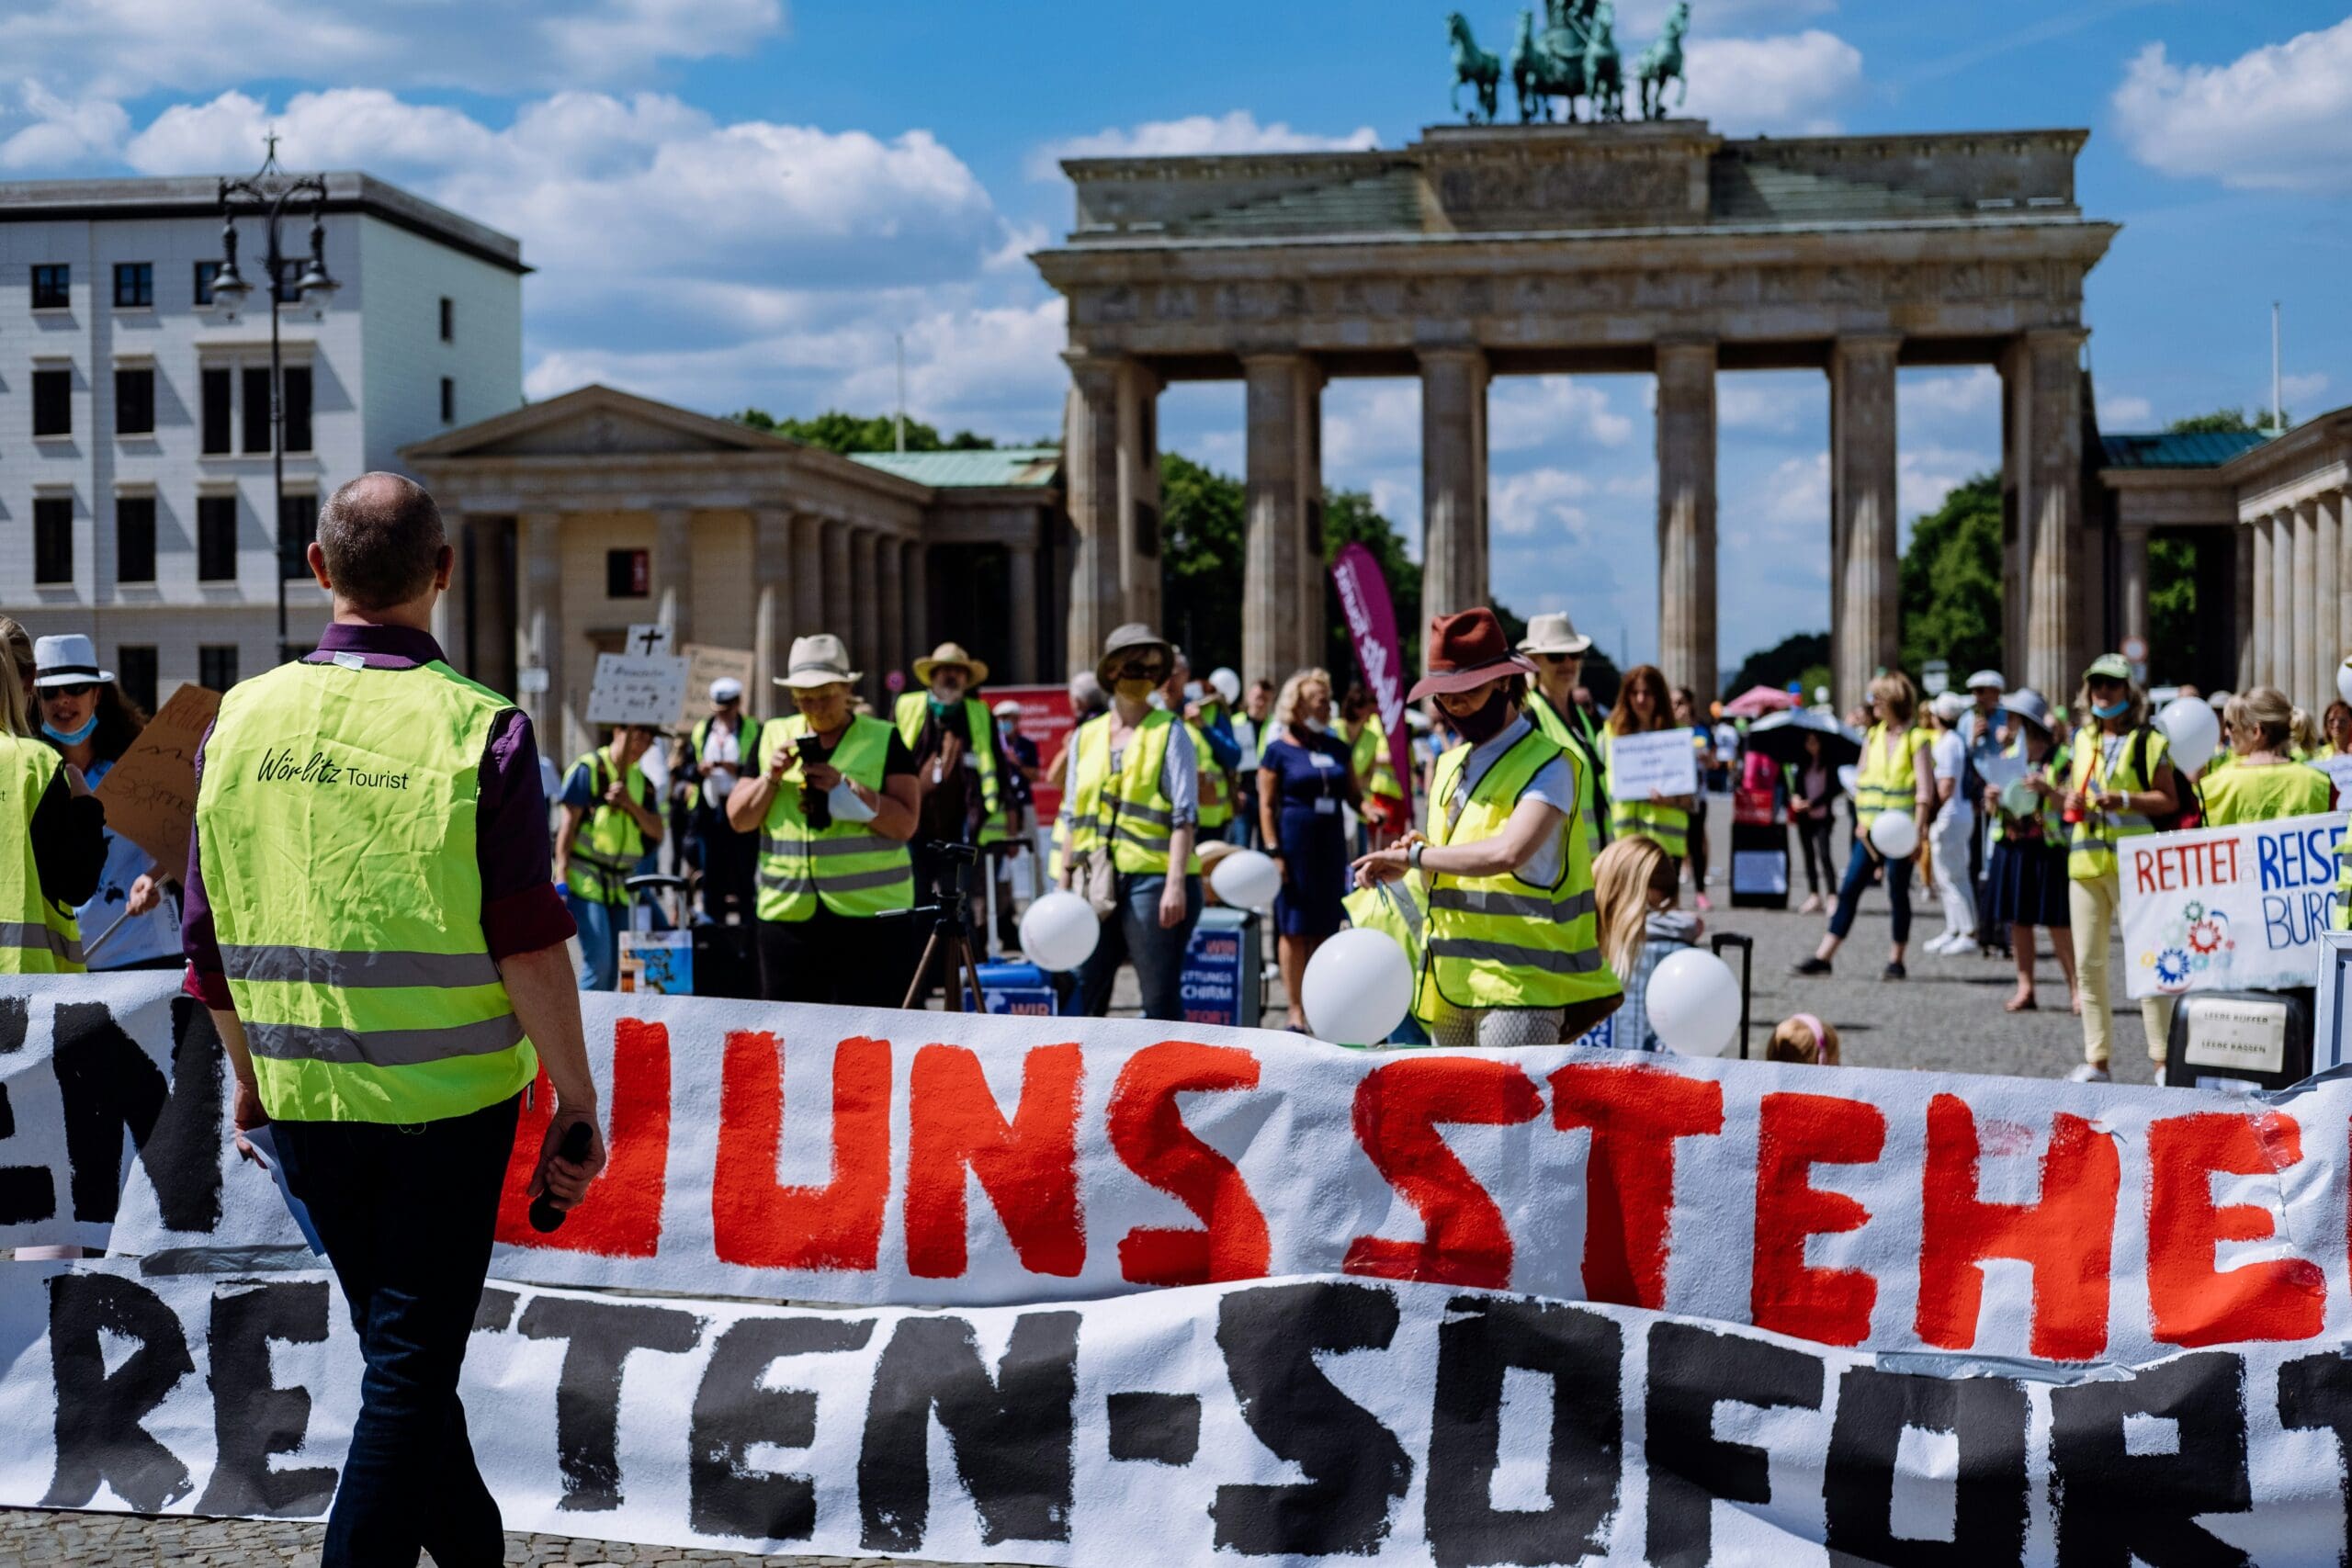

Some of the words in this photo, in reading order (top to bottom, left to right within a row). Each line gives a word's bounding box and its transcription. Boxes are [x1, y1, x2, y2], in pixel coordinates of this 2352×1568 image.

[257, 748, 342, 784] Wörlitz
[346, 768, 409, 790] Tourist
[2134, 837, 2241, 895] RETTET
[712, 1028, 1272, 1286] UNS
[1342, 1055, 2352, 1363] STEHE
